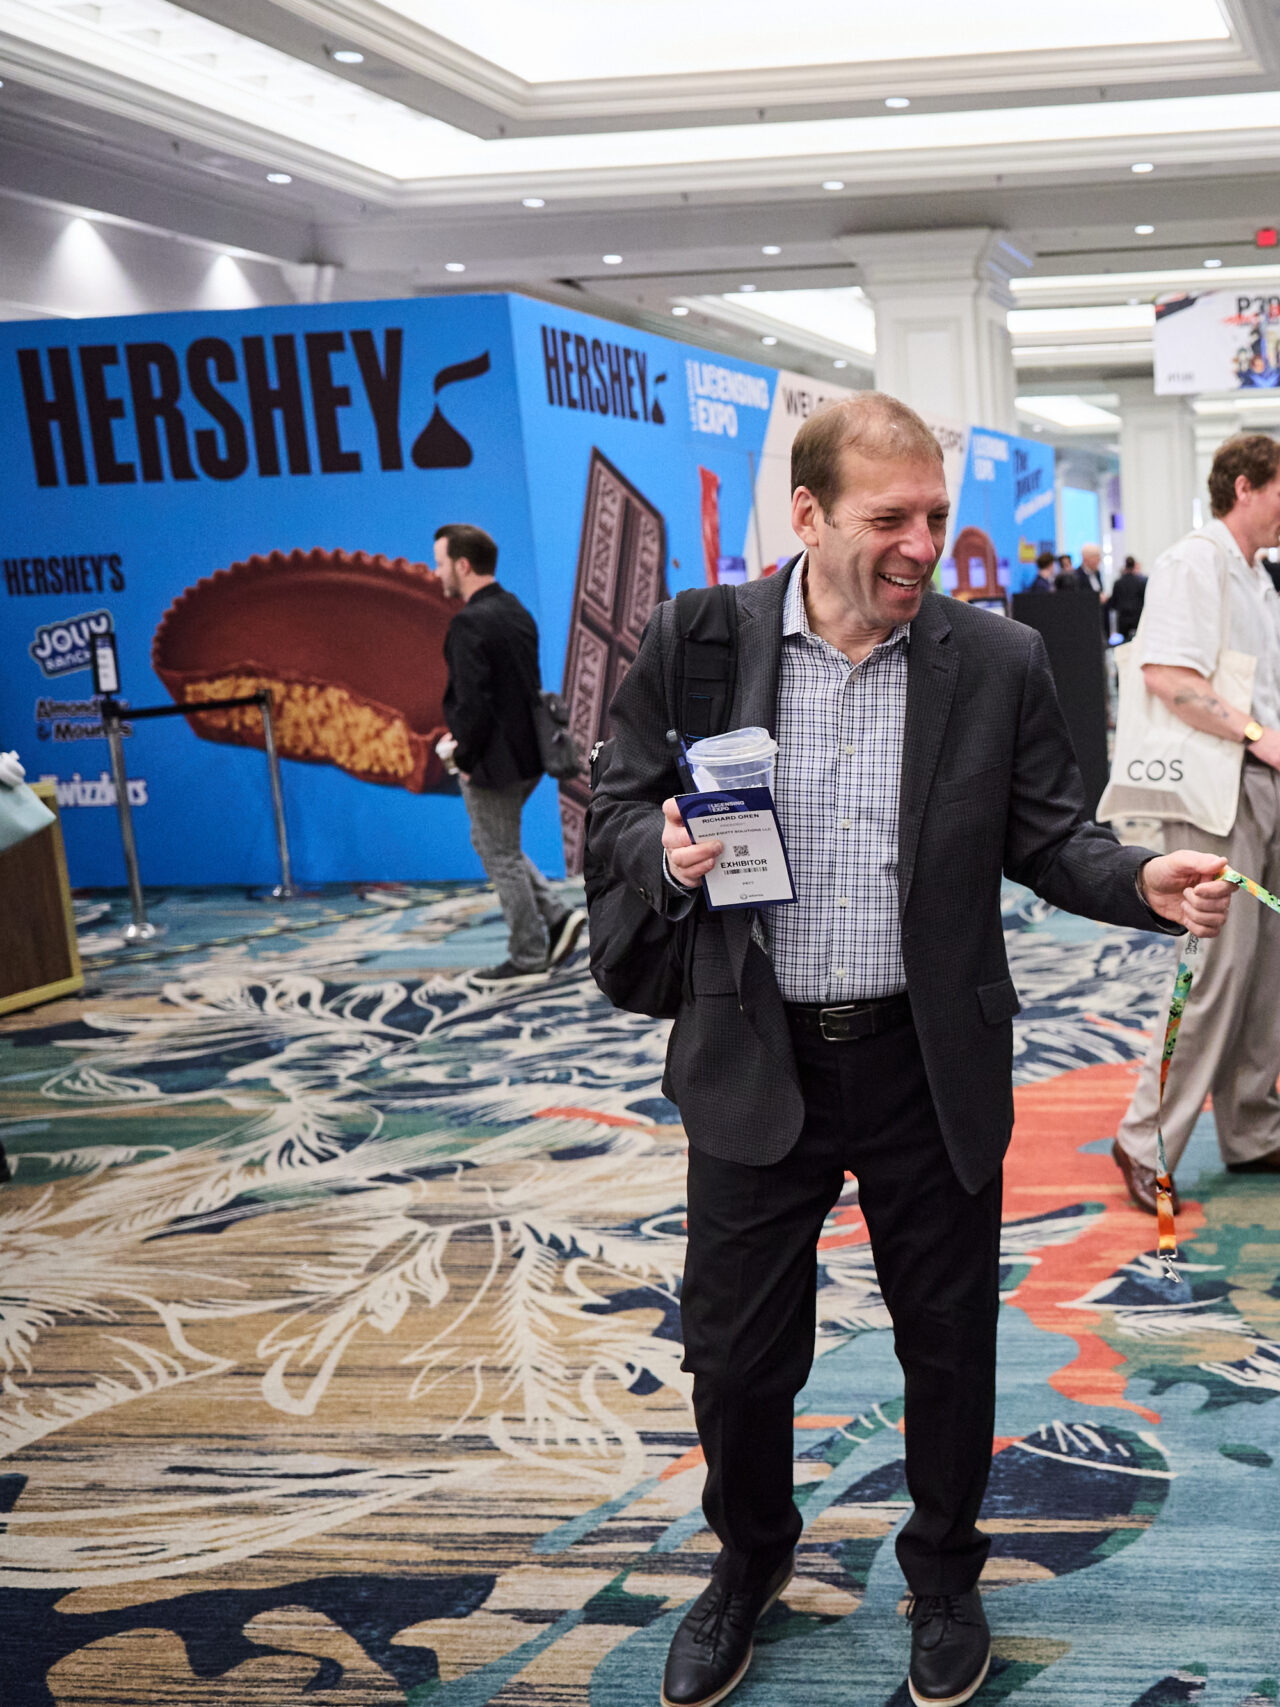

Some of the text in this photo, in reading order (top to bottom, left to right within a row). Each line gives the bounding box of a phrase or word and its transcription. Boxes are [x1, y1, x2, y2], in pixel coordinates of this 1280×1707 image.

[541, 324, 649, 422] HERSHEY
[694, 361, 770, 411] LICENSING
[17, 327, 403, 487] HERSHEY
[696, 397, 738, 438] EXPO
[4, 554, 125, 597] HERSHEY'S
[53, 720, 133, 742] Mouns
[1127, 759, 1184, 782] COS
[702, 814, 736, 824] RICHARD
[720, 858, 768, 869] EXHIBITOR
